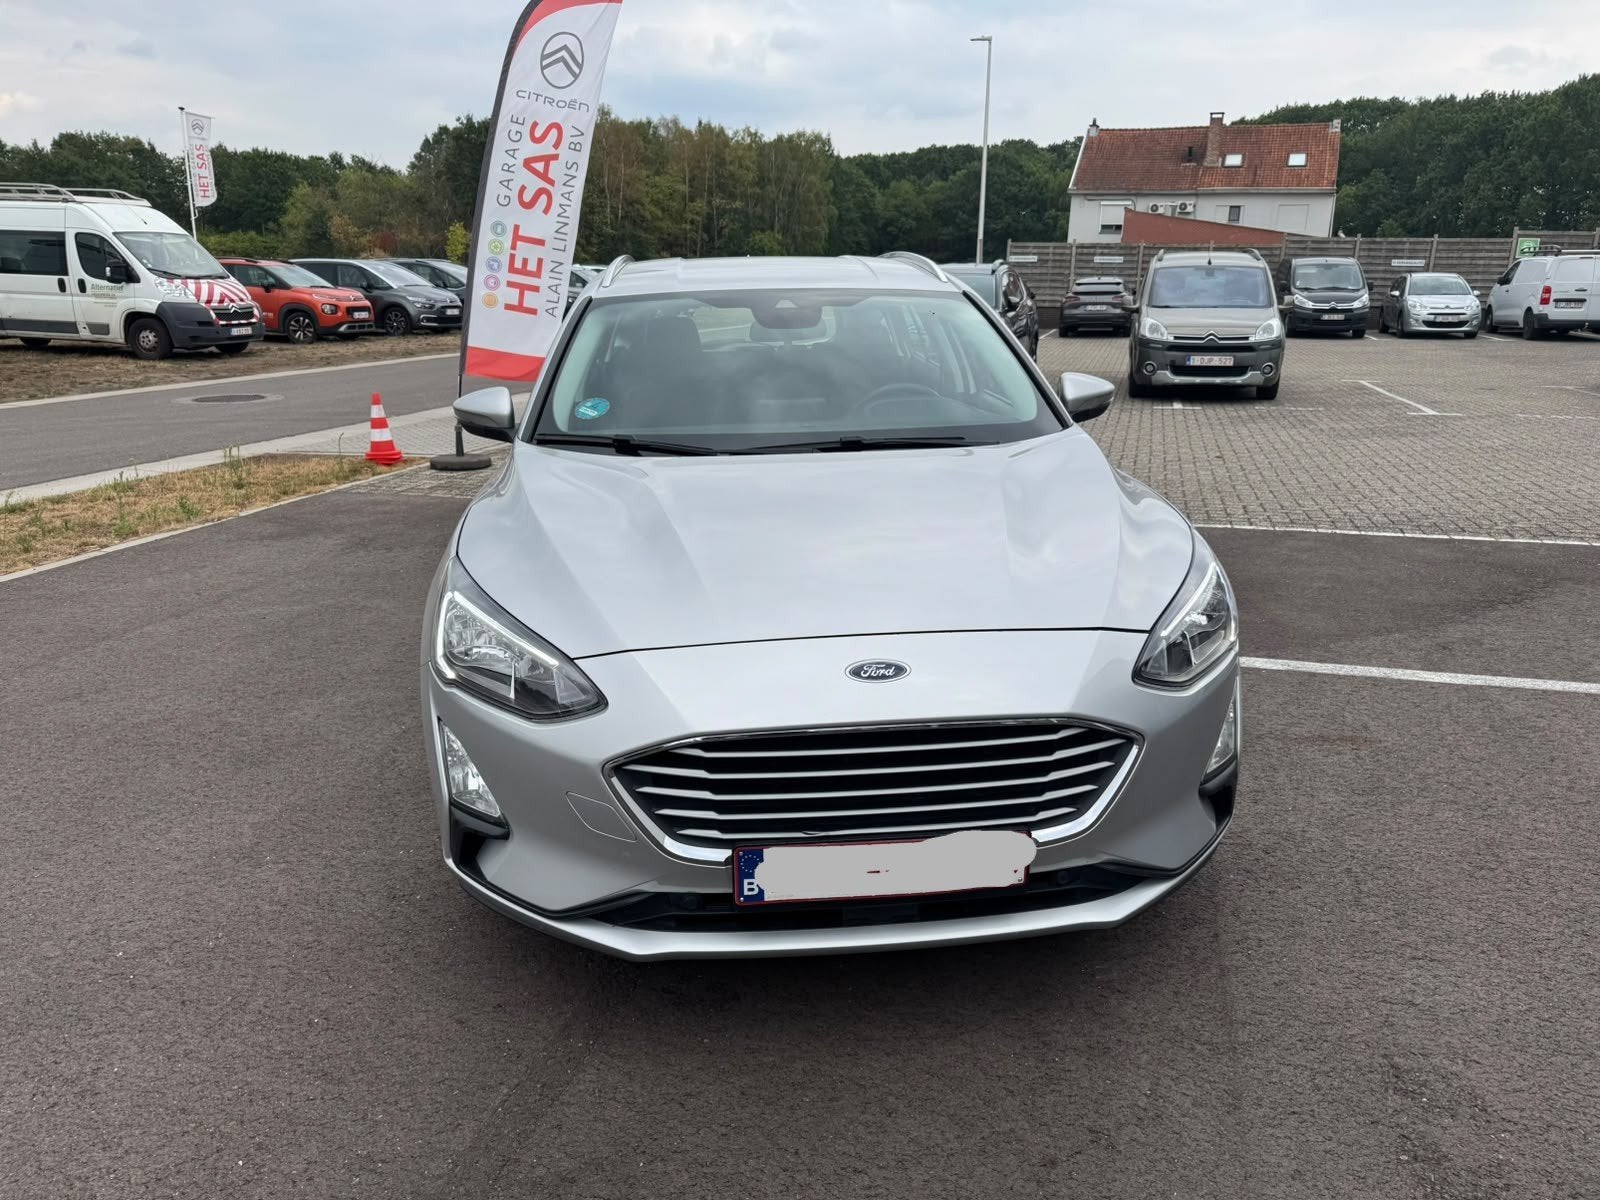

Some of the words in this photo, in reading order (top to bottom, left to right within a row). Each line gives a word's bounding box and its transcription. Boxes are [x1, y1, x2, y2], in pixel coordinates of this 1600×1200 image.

[195, 144, 207, 170] SAS
[567, 125, 585, 153] BV
[496, 114, 526, 208] GARAGE
[517, 119, 564, 216] SAS
[198, 174, 210, 198] HET
[552, 160, 579, 253] LINMANS
[503, 223, 546, 316] HET
[544, 260, 564, 318] ALAIN
[860, 664, 896, 678] Ford
[743, 878, 759, 896] B
